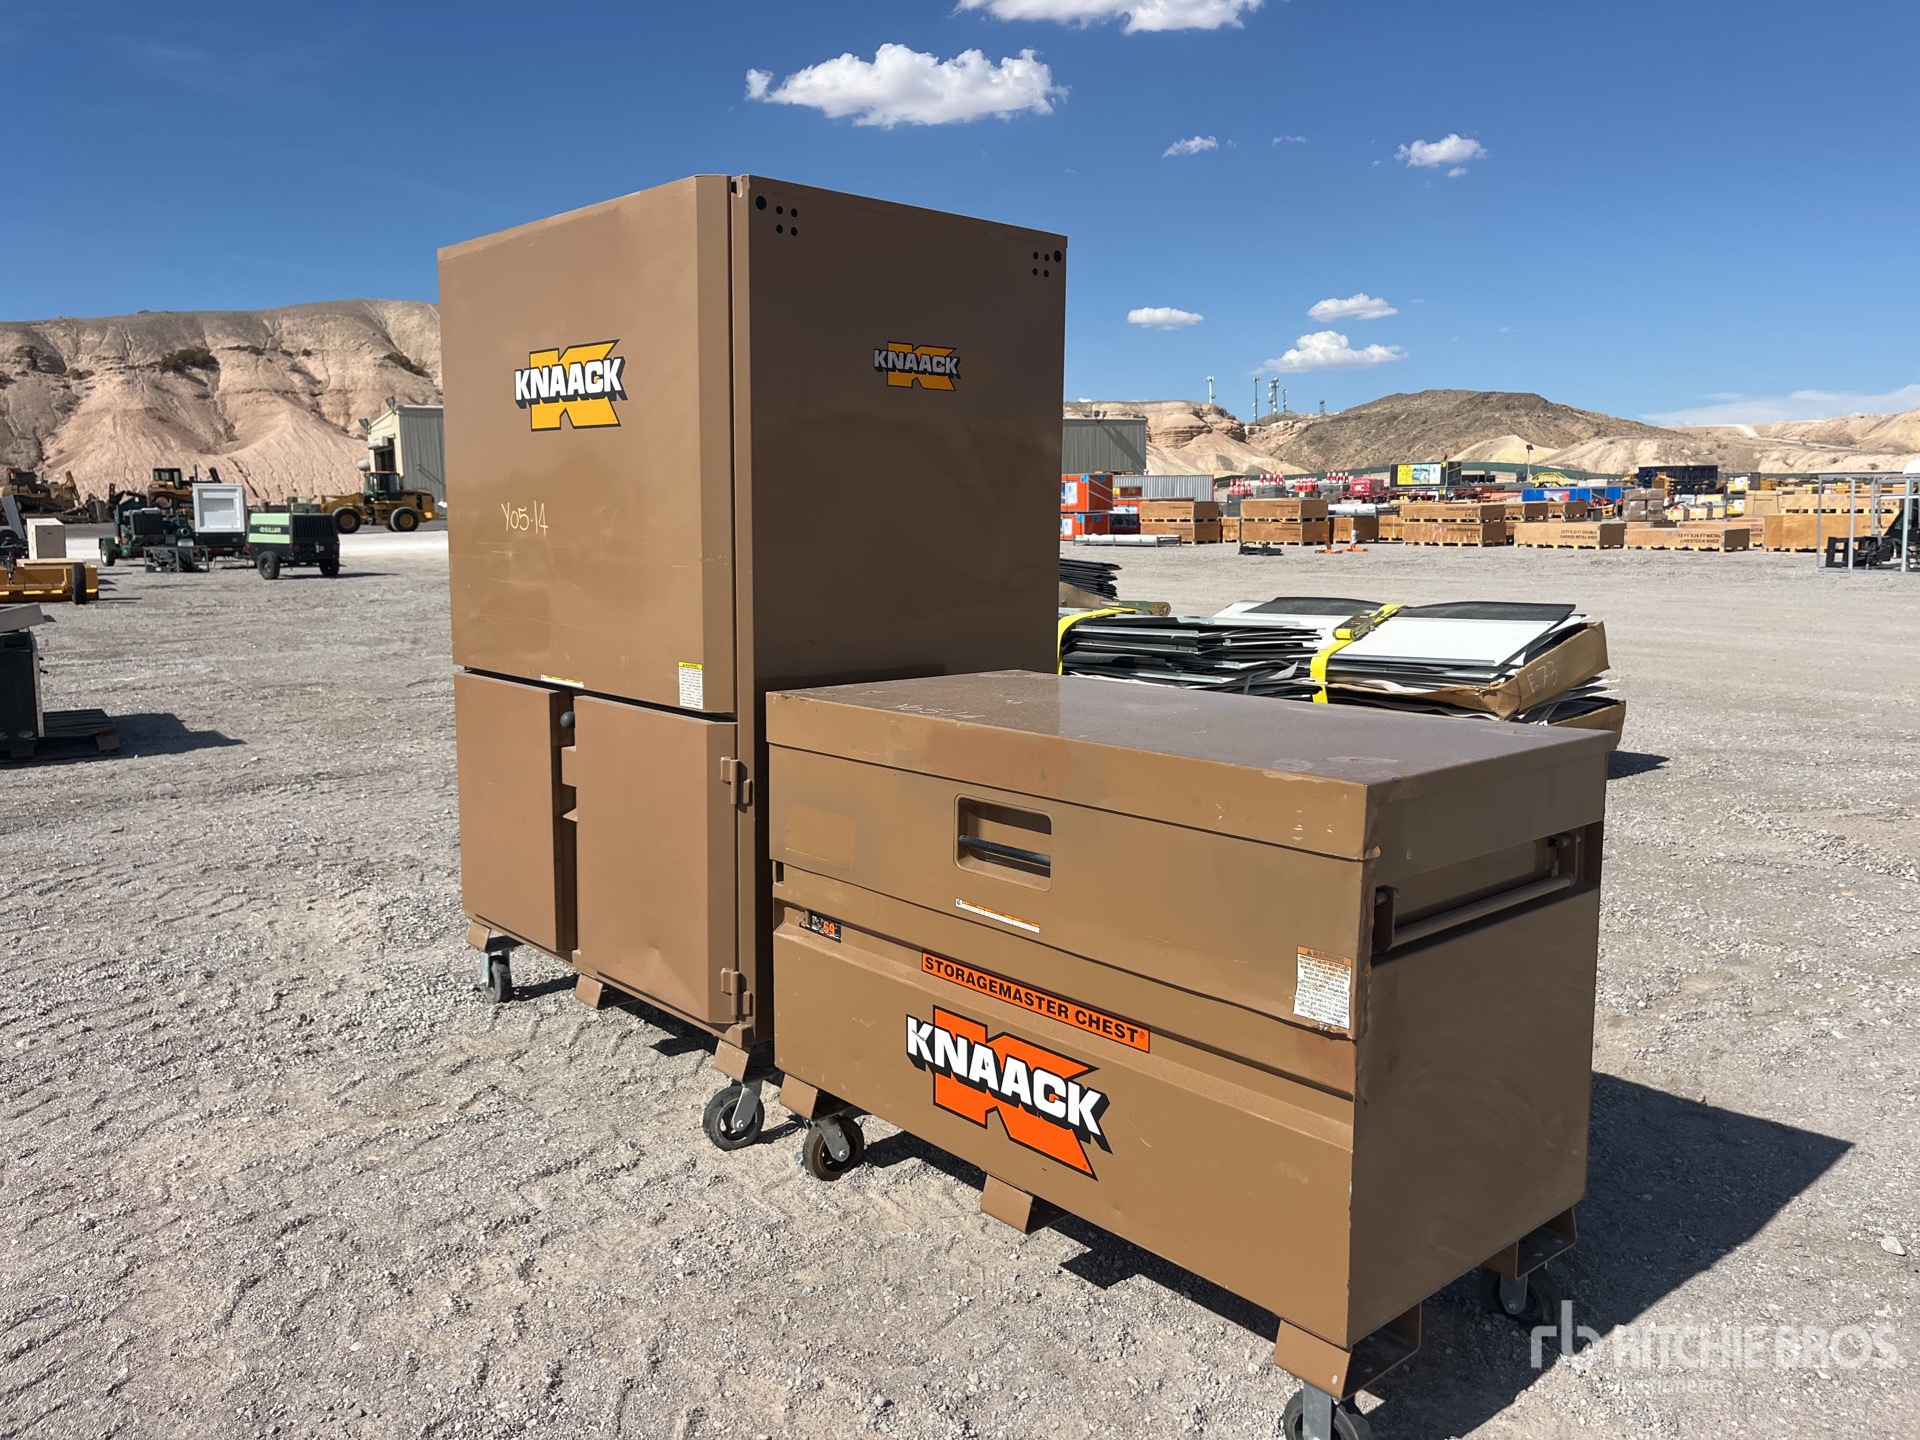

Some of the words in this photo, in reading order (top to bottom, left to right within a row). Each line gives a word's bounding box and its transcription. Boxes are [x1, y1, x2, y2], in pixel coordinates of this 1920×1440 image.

[514, 357, 623, 403] KNAACK
[874, 349, 960, 377] KNAACK
[925, 956, 1069, 1020] STORAGEMASTER
[907, 1015, 1106, 1141] KNAACK
